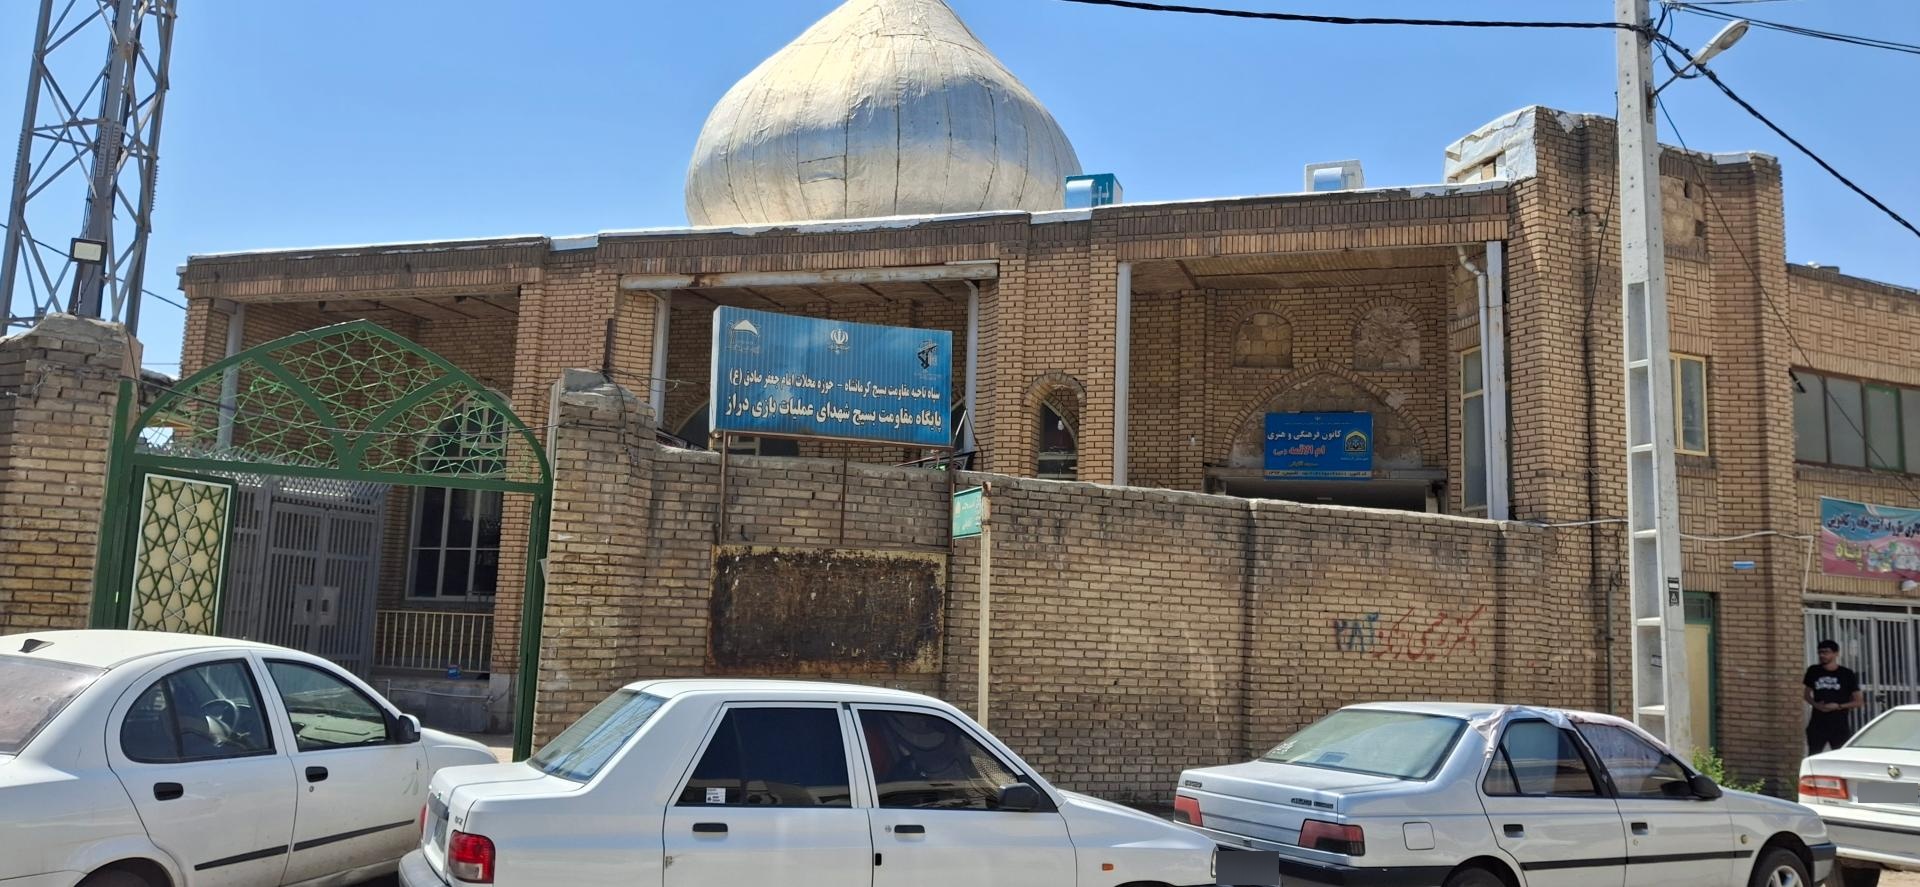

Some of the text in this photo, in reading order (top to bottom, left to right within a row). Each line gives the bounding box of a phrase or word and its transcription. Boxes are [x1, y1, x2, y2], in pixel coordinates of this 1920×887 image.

[743, 369, 762, 386] صادق
[763, 371, 780, 388] جعفر
[781, 372, 795, 390] امام
[796, 374, 816, 388] محلات
[817, 378, 834, 394] حوزه
[844, 378, 871, 398] کرمانشاه
[872, 384, 887, 398] بسیج
[888, 384, 910, 400] مقاومت
[911, 385, 926, 400] ناحیه
[725, 393, 942, 432] پایگاه مقاومت بسیج شهدای عملیات بازی دراز
[1267, 431, 1286, 440] هنری
[1293, 430, 1320, 440] فرهنگی
[1321, 430, 1342, 441] کانون
